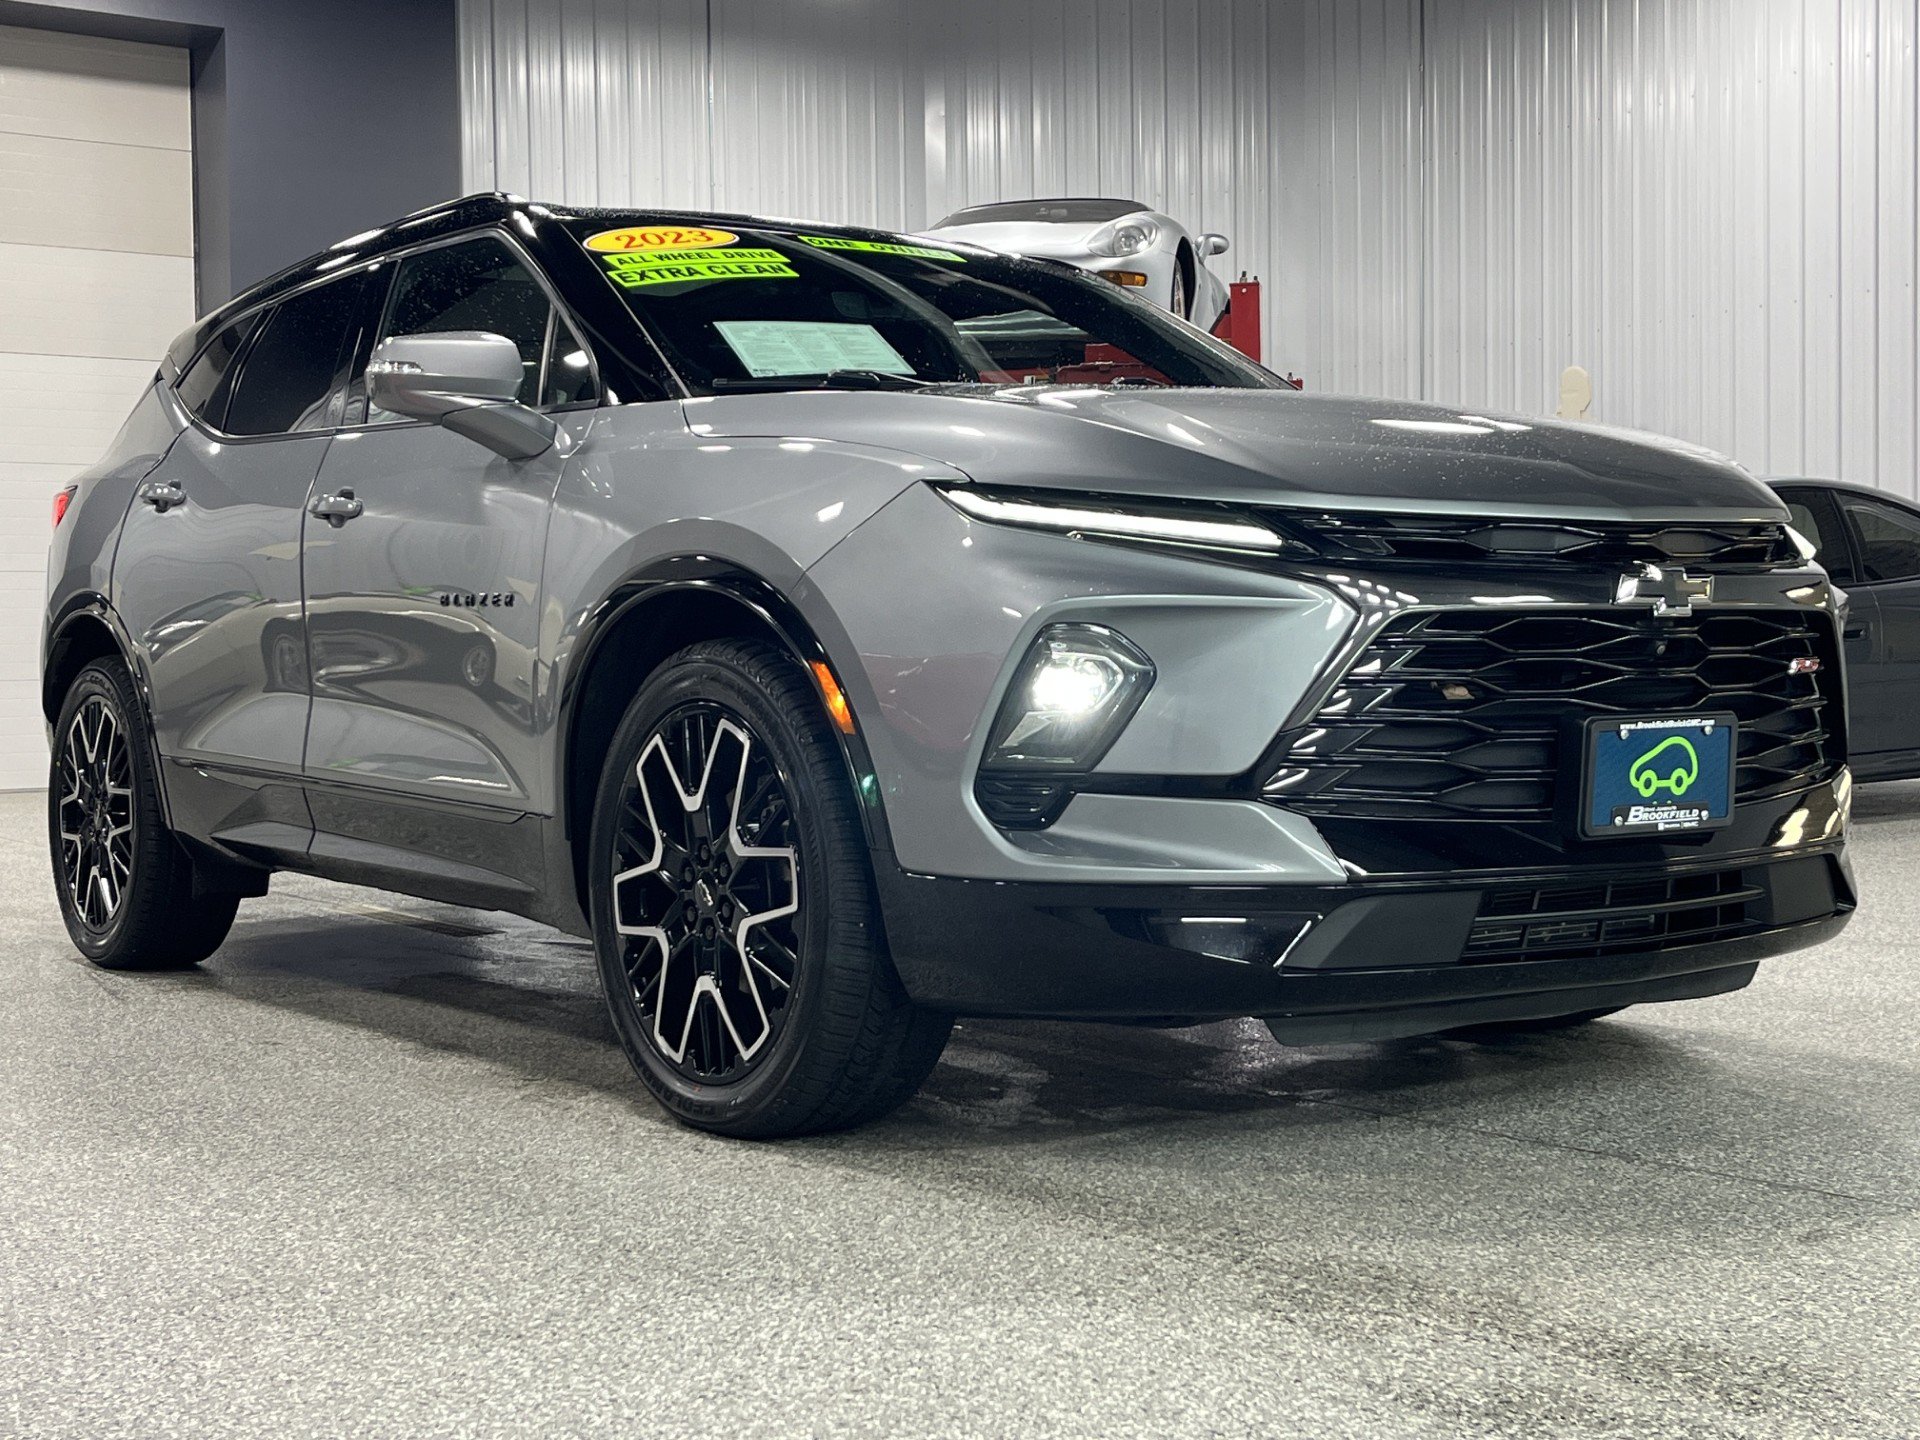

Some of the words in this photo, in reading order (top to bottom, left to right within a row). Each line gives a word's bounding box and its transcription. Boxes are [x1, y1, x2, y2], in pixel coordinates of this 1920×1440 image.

[615, 230, 714, 249] 2023
[807, 237, 854, 248] ONE
[616, 255, 653, 266] ALL
[655, 250, 716, 262] WHEEL
[721, 249, 780, 260] DRIVE
[615, 265, 705, 284] EXTRA
[709, 262, 789, 276] CLEAN
[440, 592, 516, 608] BLAZER
